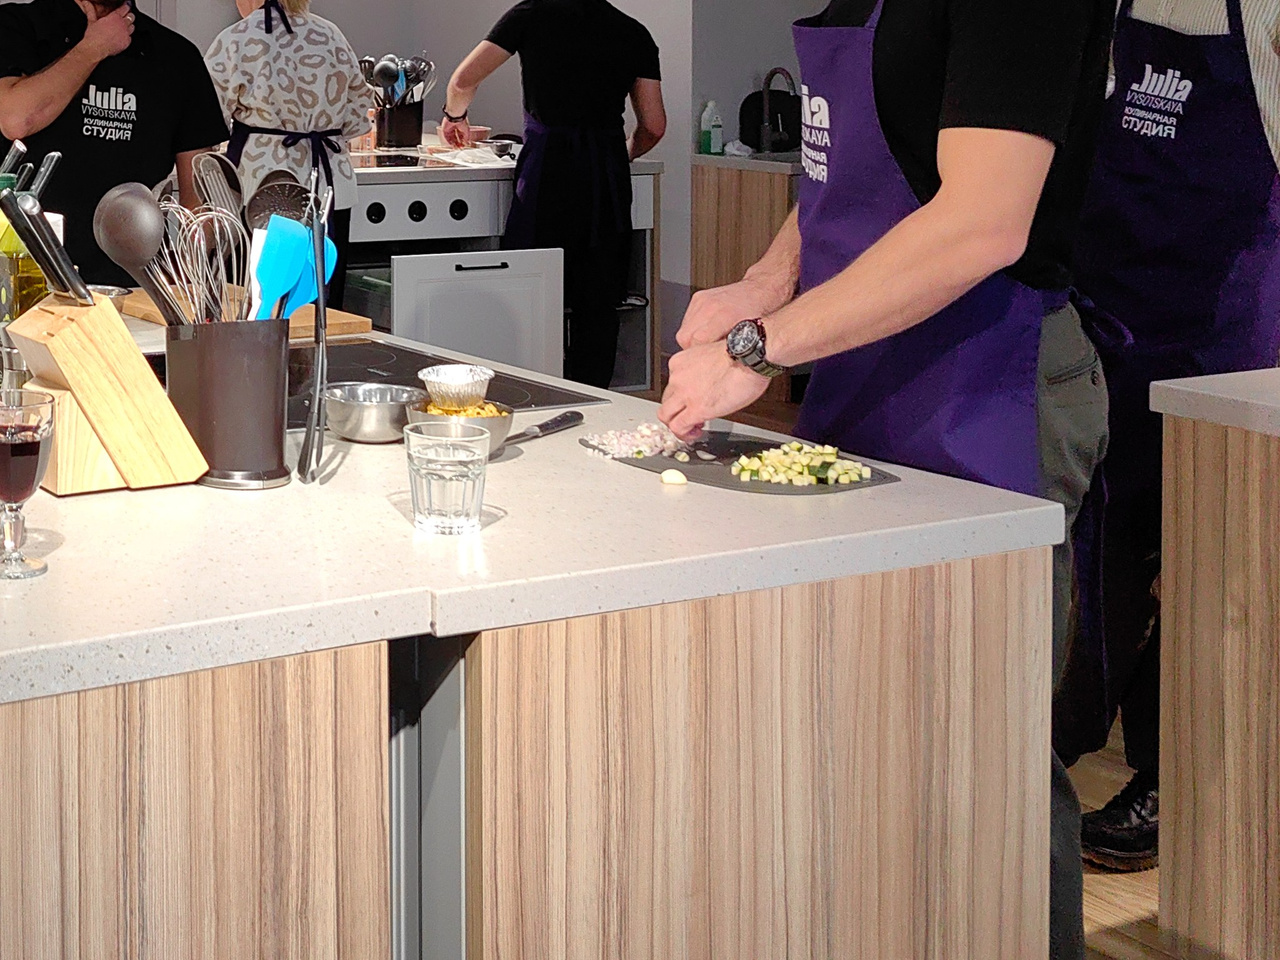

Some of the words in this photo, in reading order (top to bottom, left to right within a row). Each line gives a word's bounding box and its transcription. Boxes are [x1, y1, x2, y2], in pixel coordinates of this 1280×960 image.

[1130, 63, 1193, 102] Julia
[82, 84, 137, 111] Julia
[1125, 90, 1184, 115] VYSOTSKAYA
[81, 104, 137, 121] VYSOTSKAYA
[83, 117, 133, 130] КУЛИНАРНАЯ
[1124, 106, 1177, 126] КУЛИНАРНАЯ
[82, 125, 132, 141] СТУДИЯ
[1122, 115, 1176, 139] СТУДИЯ
